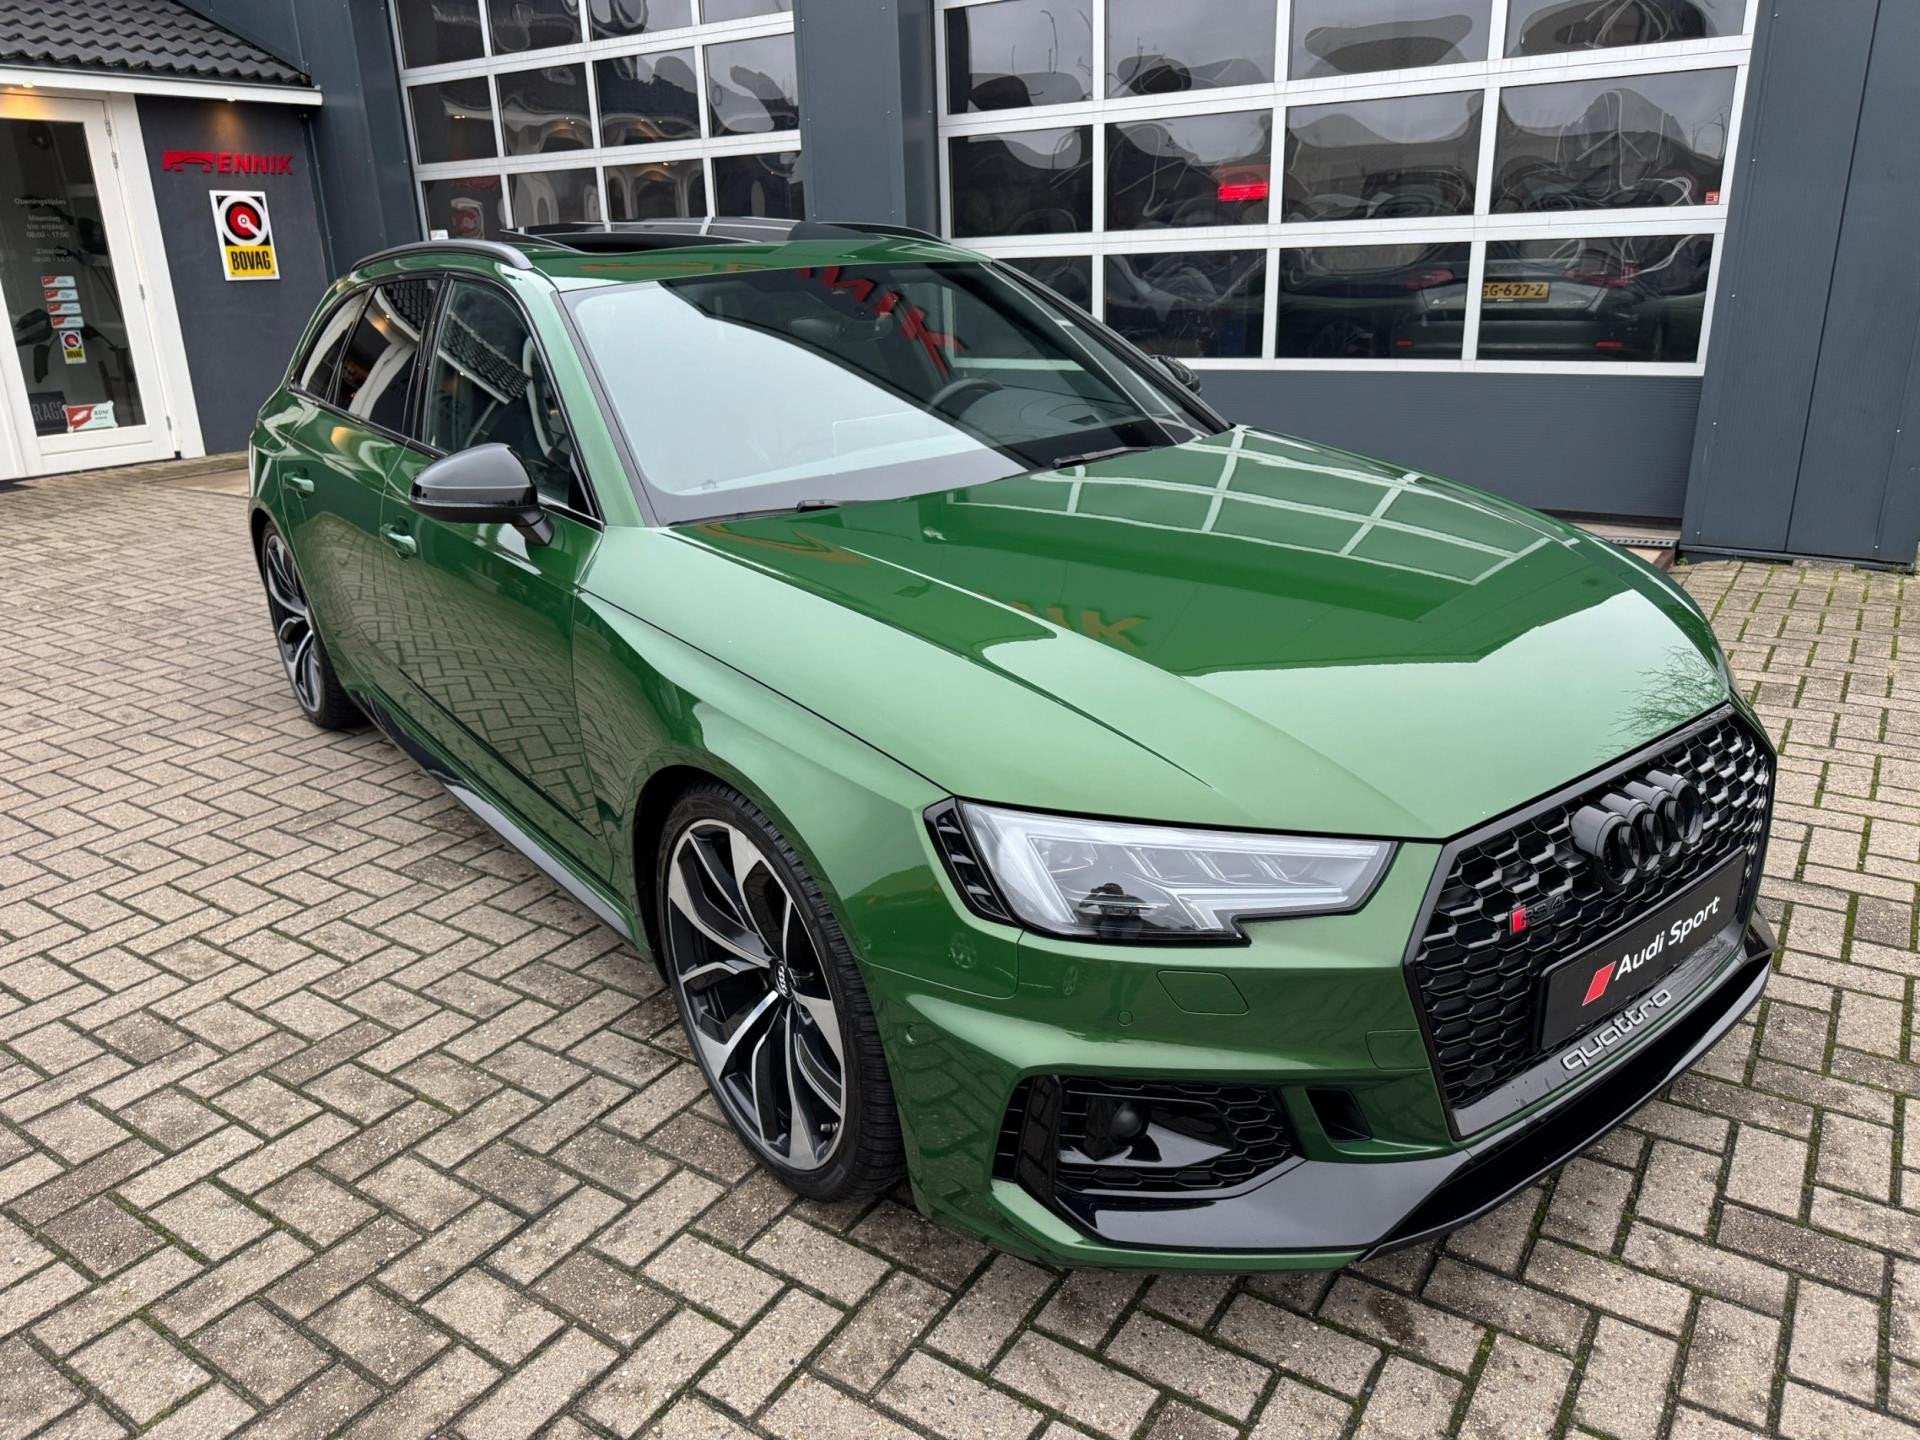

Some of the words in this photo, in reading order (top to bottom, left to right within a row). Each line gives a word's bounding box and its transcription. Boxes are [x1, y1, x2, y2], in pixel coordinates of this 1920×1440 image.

[230, 250, 272, 271] BOVAG
[1614, 930, 1666, 982] Audi
[1668, 895, 1721, 946] Sport
[1561, 988, 1672, 1071] quattro
